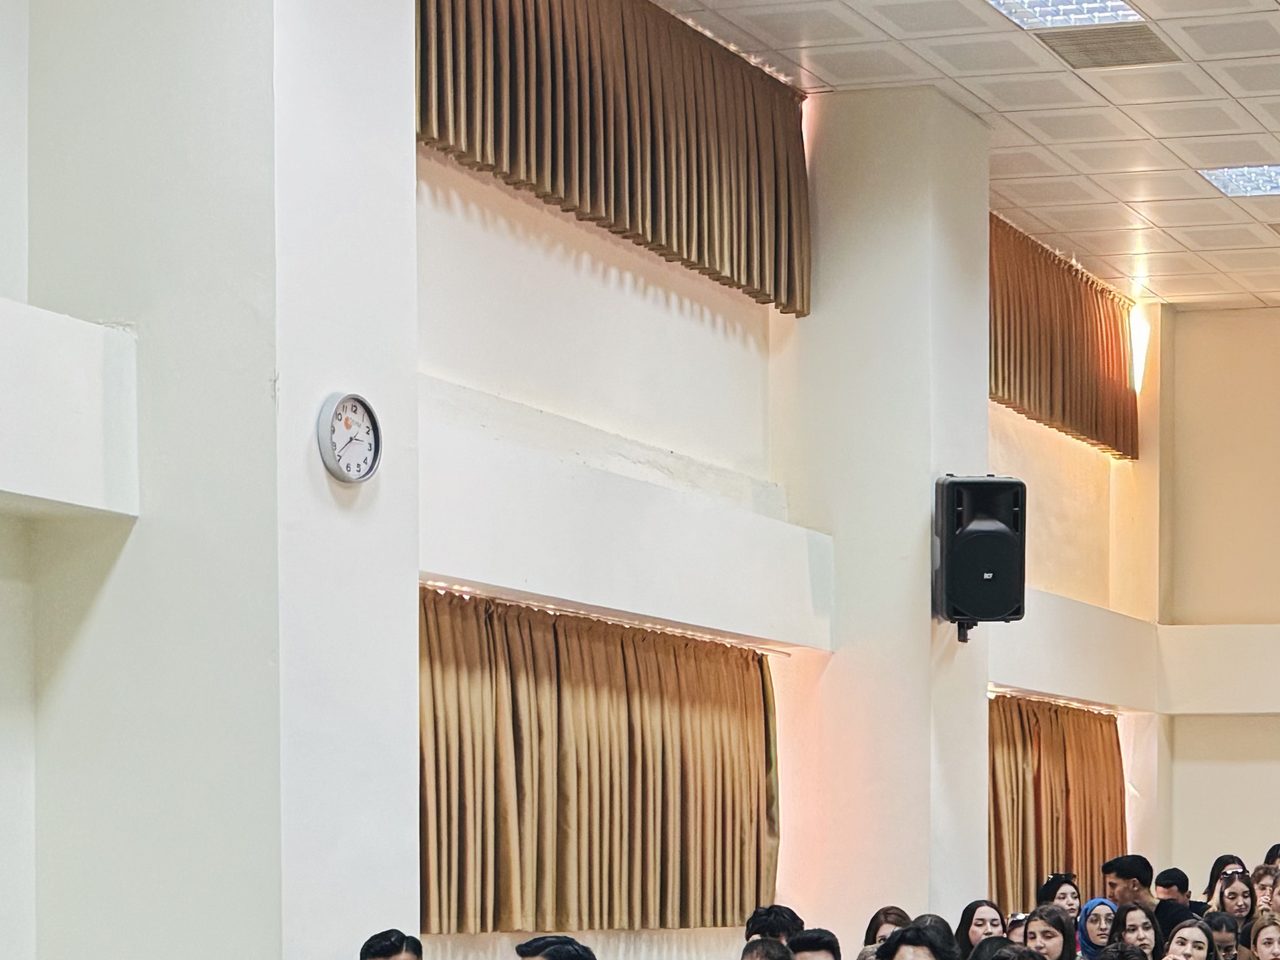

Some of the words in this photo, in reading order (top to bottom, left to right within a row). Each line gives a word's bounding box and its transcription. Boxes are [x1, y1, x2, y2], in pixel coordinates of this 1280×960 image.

[351, 403, 358, 414] 12
[365, 426, 371, 435] 2
[337, 454, 342, 463] 7
[346, 463, 351, 472] 6
